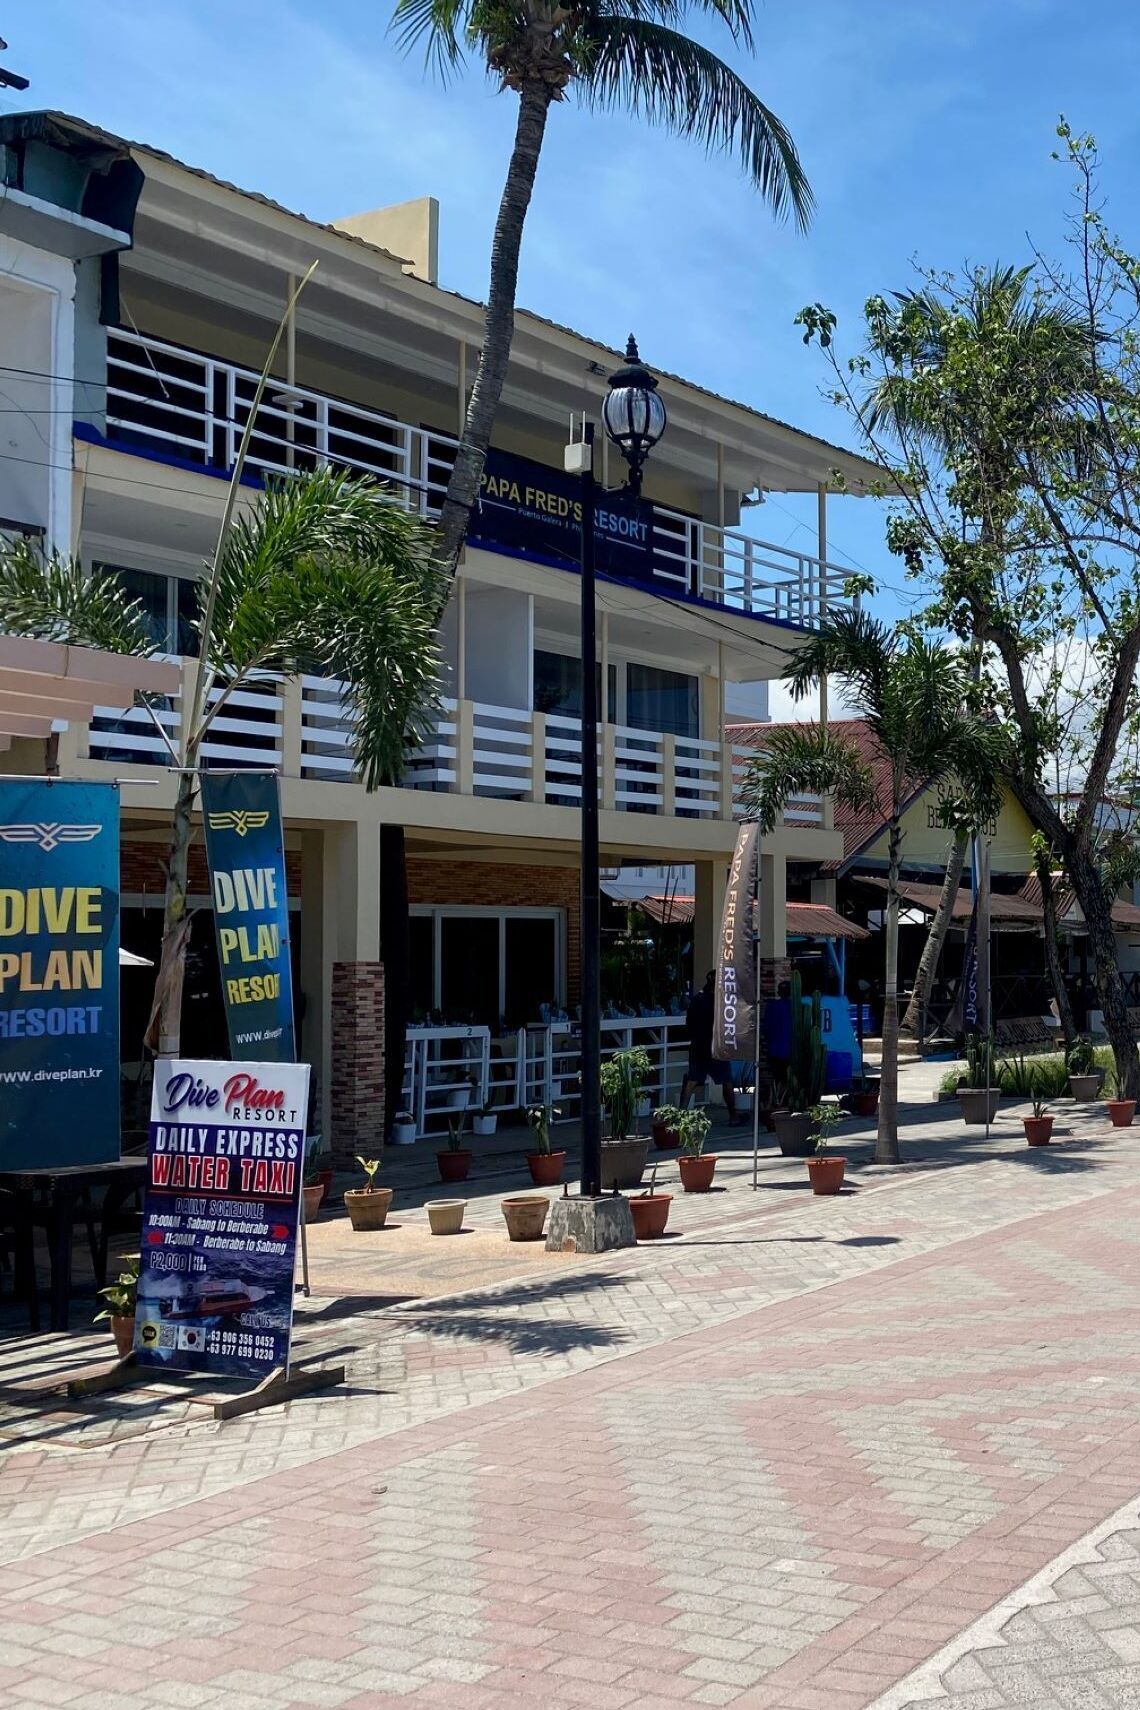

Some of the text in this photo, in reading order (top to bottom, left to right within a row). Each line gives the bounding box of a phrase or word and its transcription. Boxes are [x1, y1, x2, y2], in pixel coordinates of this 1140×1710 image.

[480, 473, 521, 503] PAPA
[525, 486, 583, 522] FRED'S
[731, 833, 750, 885] PAPA
[213, 867, 278, 914] DIVE
[0, 886, 103, 937] DIVE
[724, 890, 738, 961] FRED'S
[0, 949, 103, 994] PLAN
[723, 966, 738, 1051] RESORT
[467, 1027, 474, 1036] 2
[163, 1072, 285, 1113] Dive Plan
[233, 1107, 298, 1123] RESORT
[155, 1126, 299, 1159] DAILY EXPRESS
[152, 1153, 296, 1195] WATER TAXI
[175, 1198, 265, 1220] DAILY SCHEDULE
[187, 1216, 216, 1232] Sabang
[217, 1218, 226, 1232] to
[226, 1220, 269, 1236] Berberabe
[203, 1235, 245, 1252] Berberabe
[246, 1238, 255, 1252] to
[256, 1240, 287, 1257] Sabang
[221, 1344, 236, 1356] 977
[222, 1332, 237, 1343] 906
[239, 1333, 253, 1345] 356
